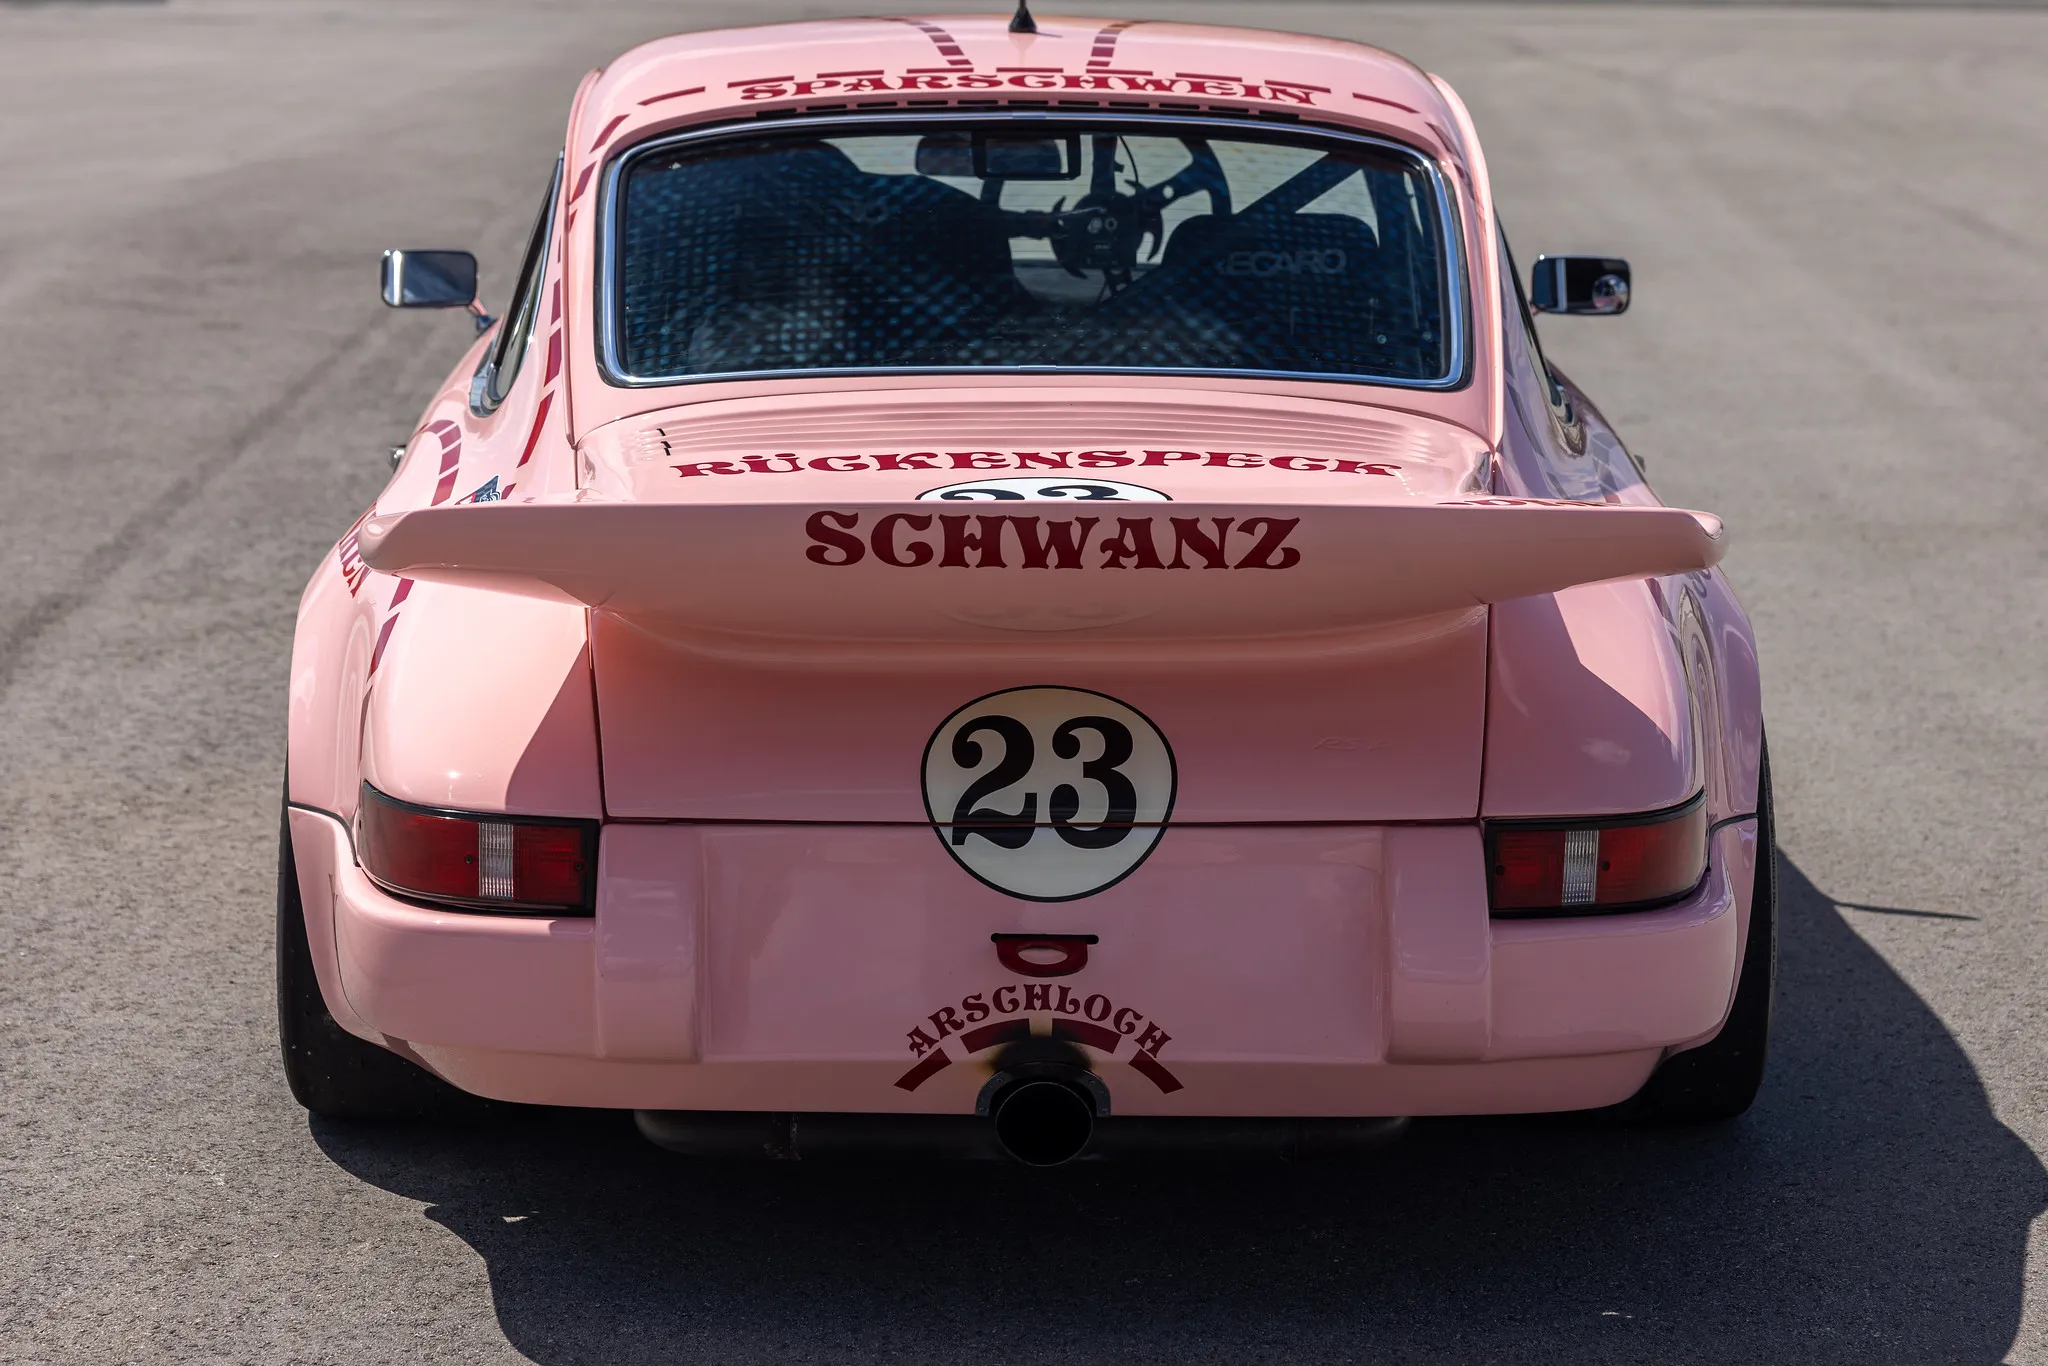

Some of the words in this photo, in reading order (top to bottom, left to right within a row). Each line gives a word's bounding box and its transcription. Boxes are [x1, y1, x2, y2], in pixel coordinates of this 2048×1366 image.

[740, 73, 1317, 105] SPARSCHWEIN
[669, 450, 1403, 479] RÜCKENSPECK
[804, 510, 1302, 570] SCHWANZ
[951, 714, 1138, 850] 23
[905, 983, 1173, 1060] ARSCHLOCH
